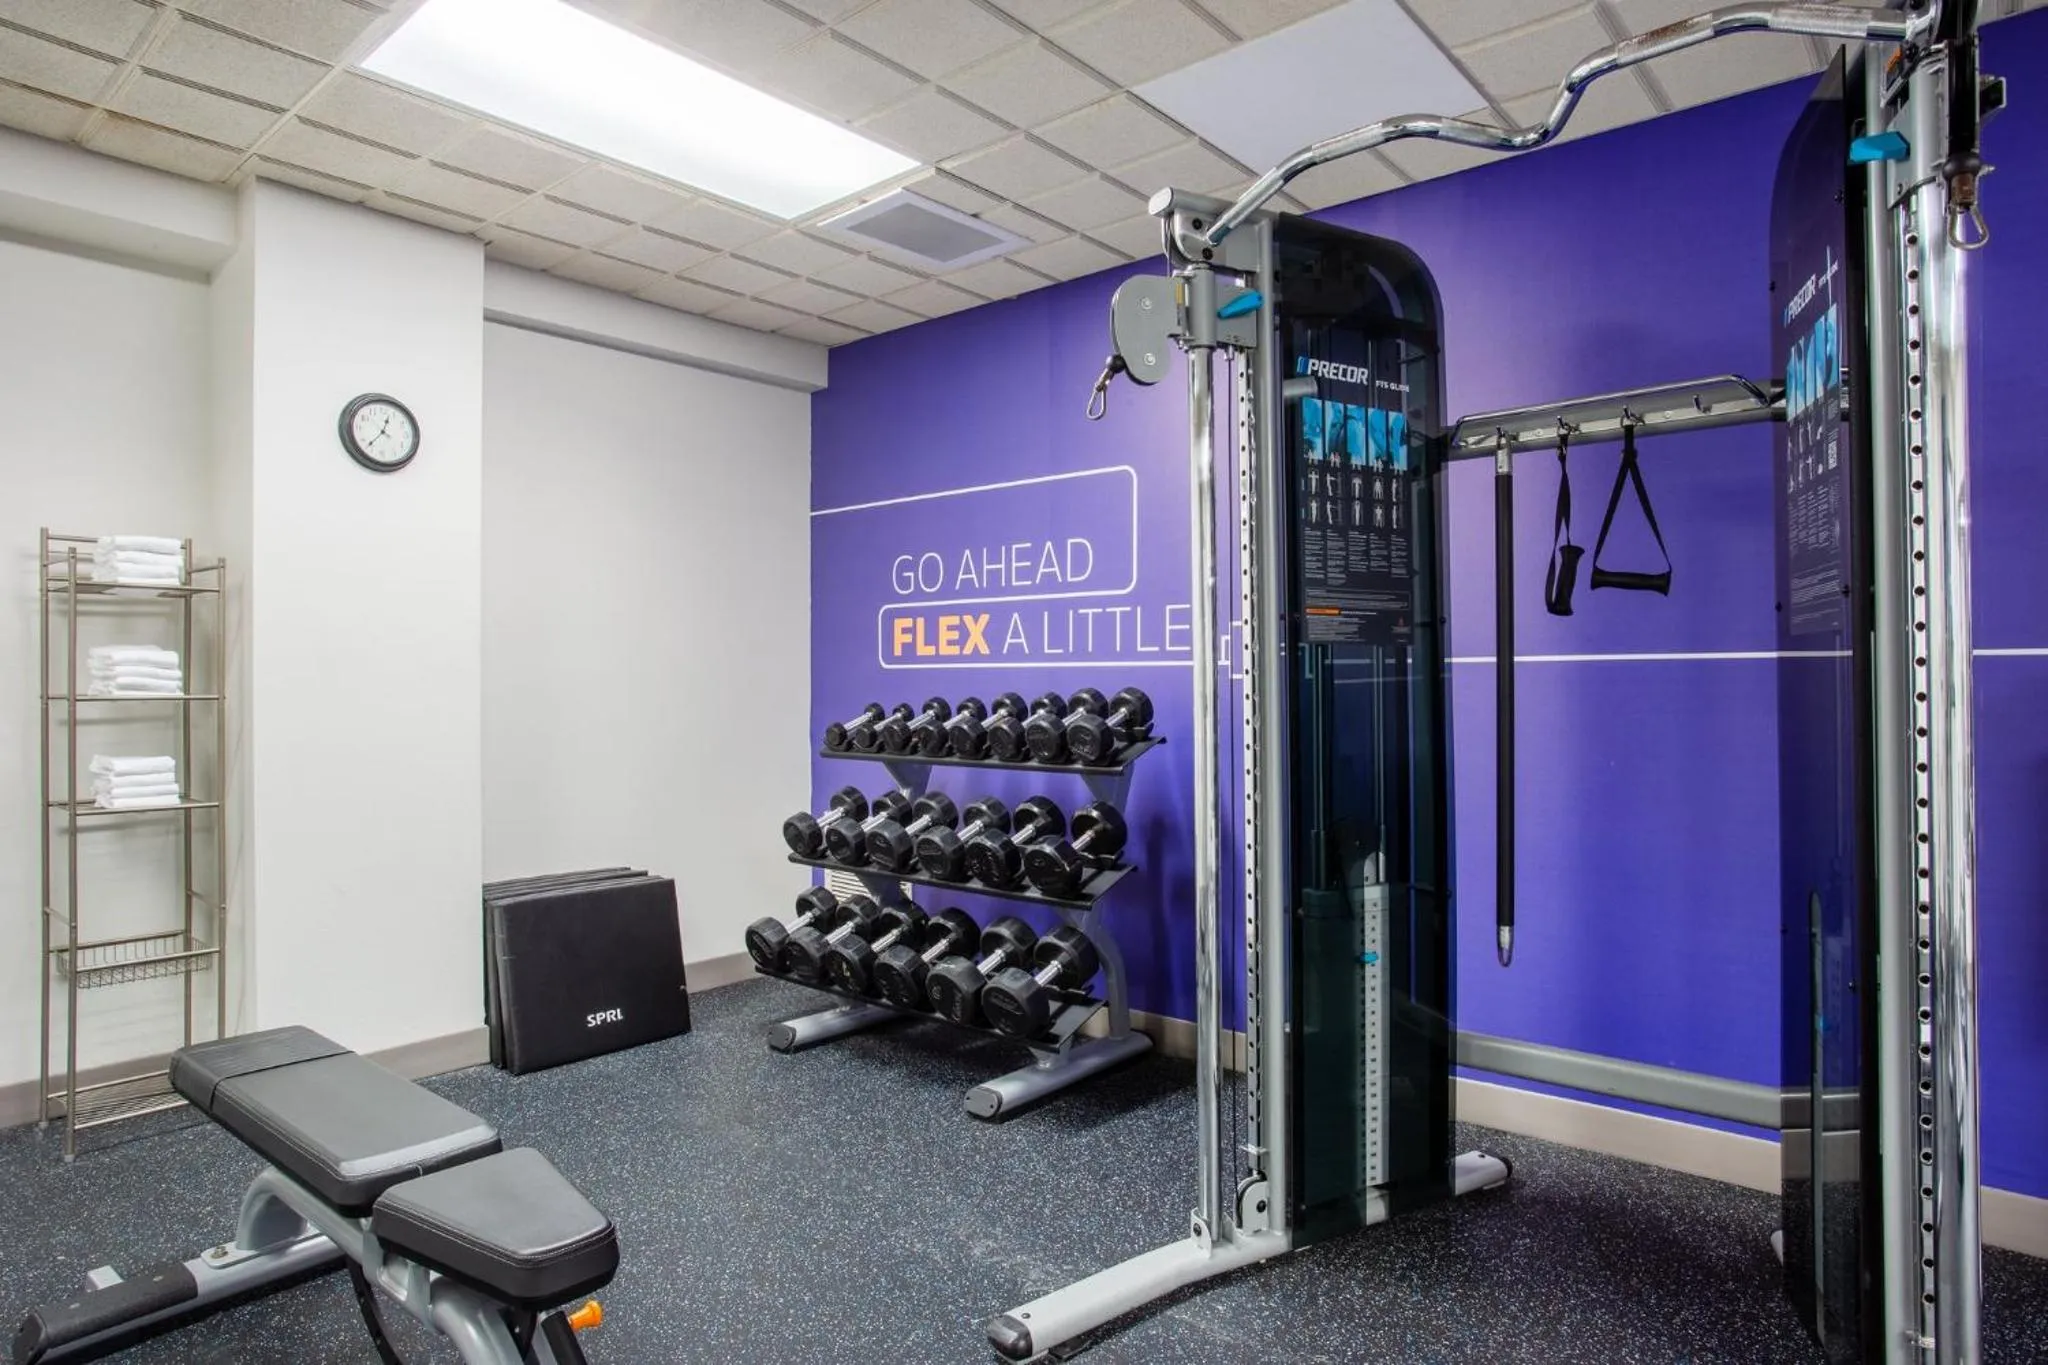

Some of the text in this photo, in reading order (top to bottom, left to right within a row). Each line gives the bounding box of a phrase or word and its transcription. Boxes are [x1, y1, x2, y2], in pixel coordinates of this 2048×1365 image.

[1308, 358, 1369, 385] PRECOR
[892, 538, 1094, 593] GO AHEAD
[892, 605, 1191, 656] FLEX A LITTLE
